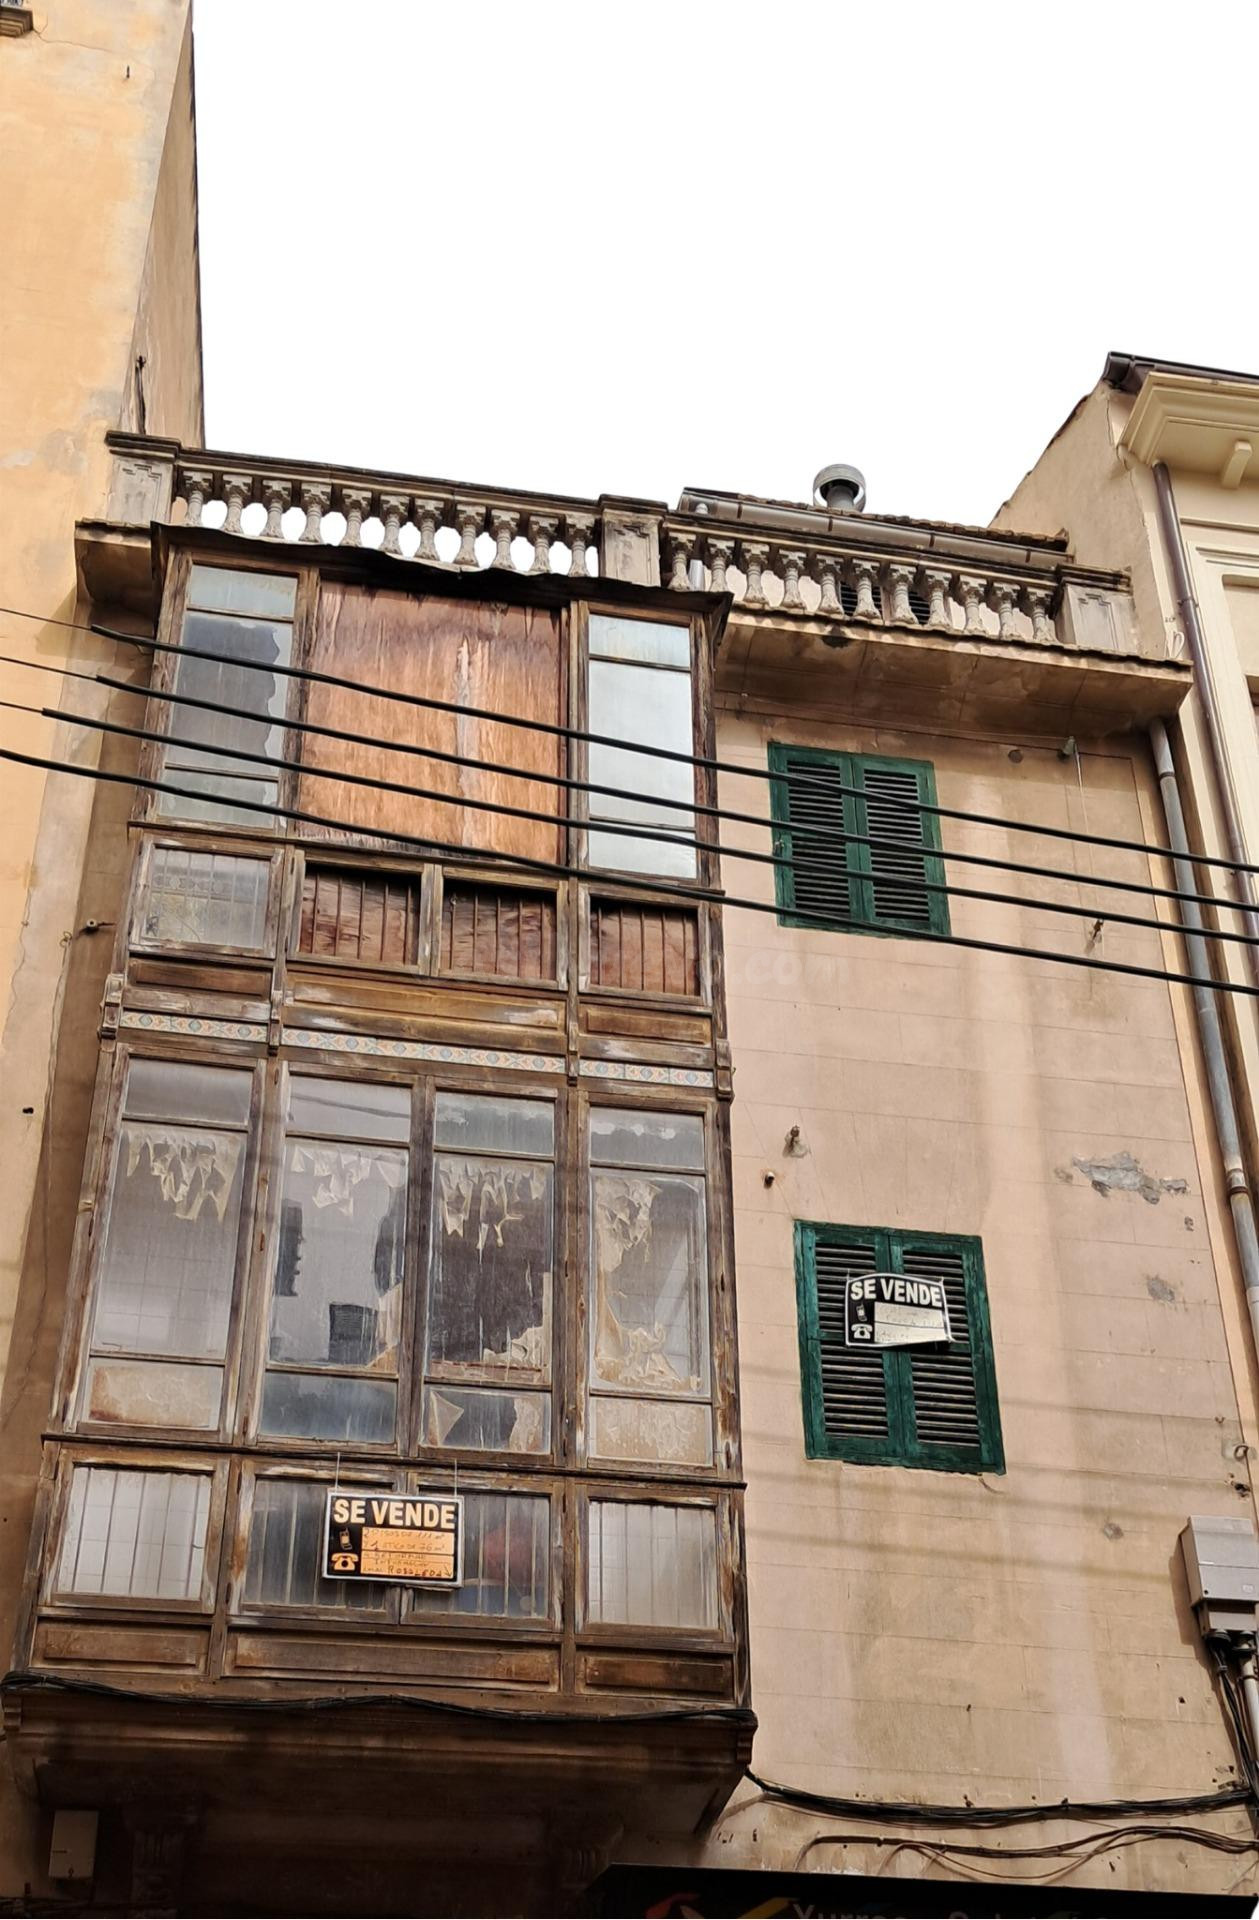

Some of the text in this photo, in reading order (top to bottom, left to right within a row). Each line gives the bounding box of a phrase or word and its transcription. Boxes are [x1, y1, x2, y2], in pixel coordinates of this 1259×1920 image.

[850, 1278, 943, 1307] SE VENDE
[333, 1498, 456, 1529] SE VENDE
